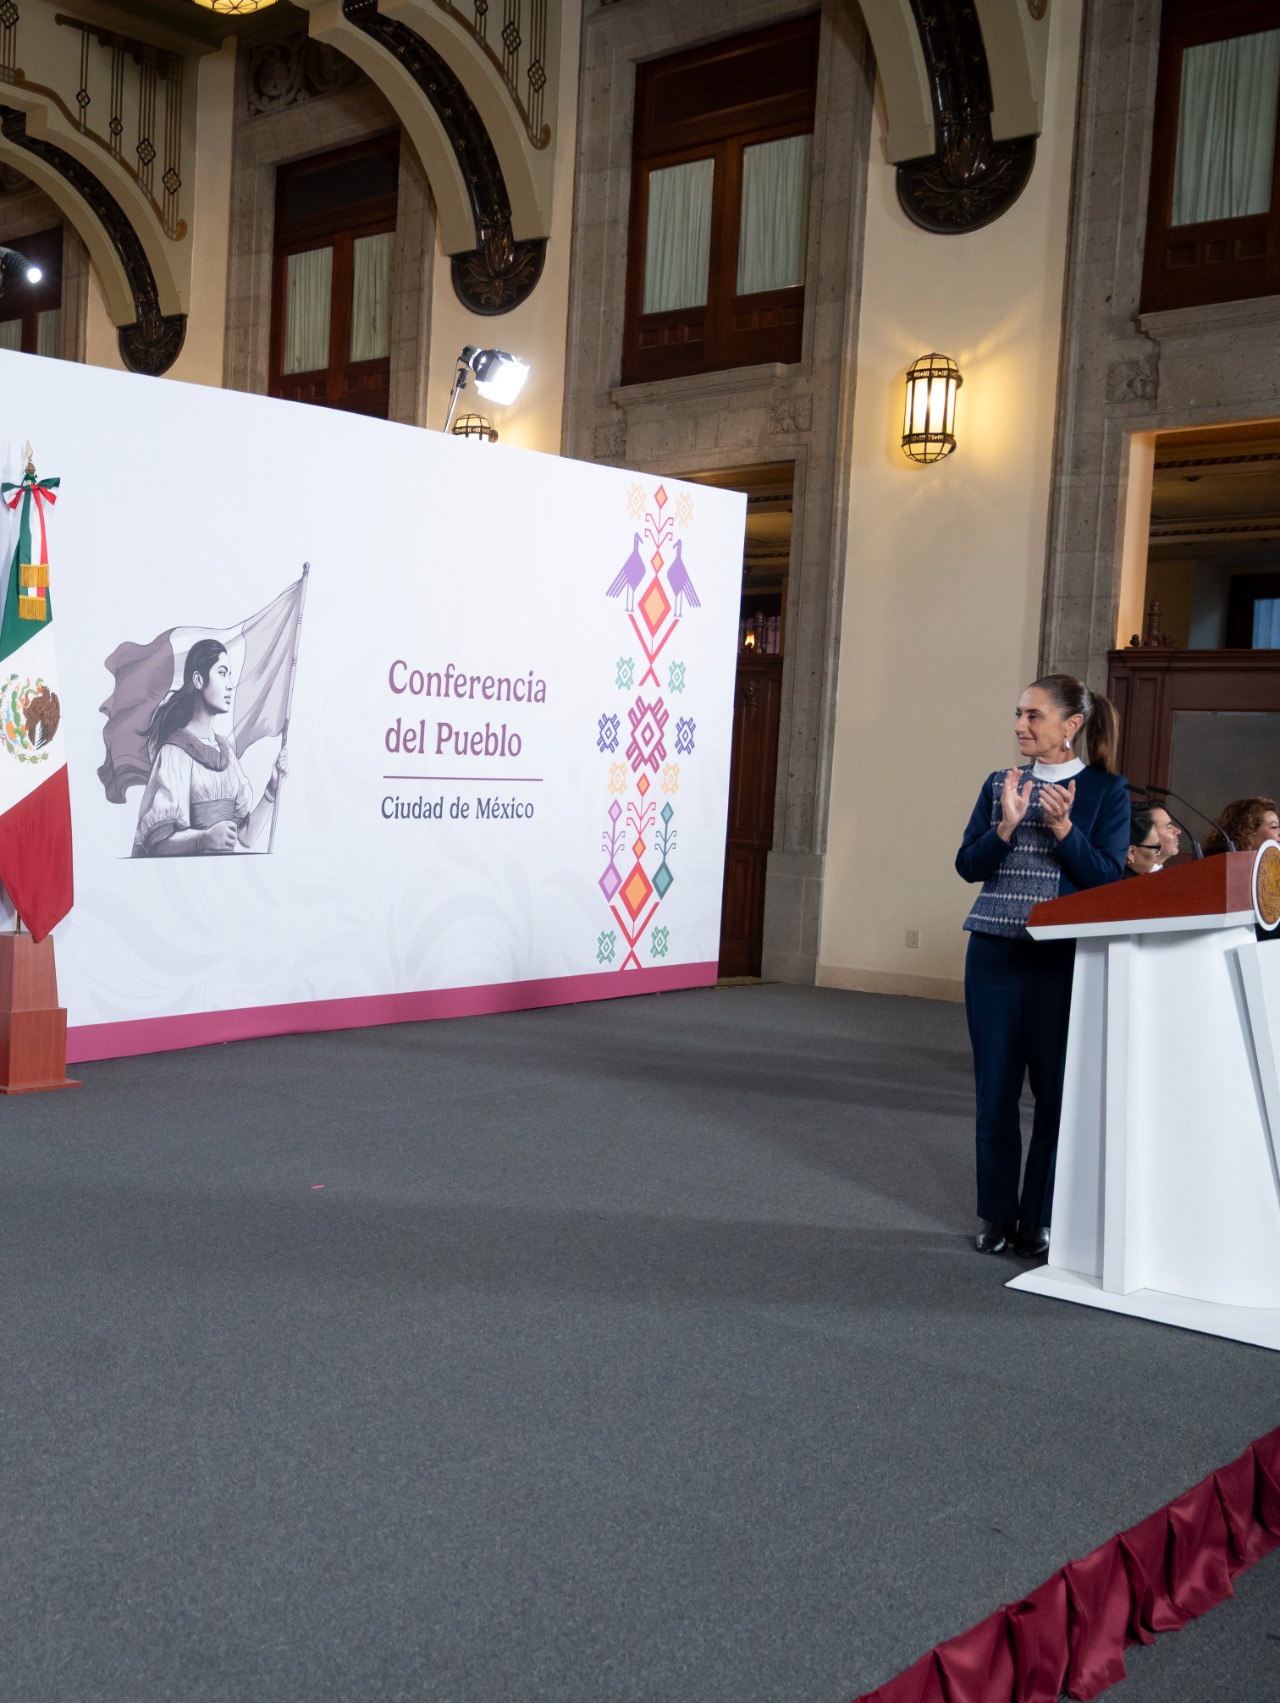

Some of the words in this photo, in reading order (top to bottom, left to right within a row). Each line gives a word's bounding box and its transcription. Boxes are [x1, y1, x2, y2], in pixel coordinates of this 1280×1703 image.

[388, 659, 547, 704] Conferencia
[384, 717, 426, 754] del
[435, 721, 522, 757] Pueblo
[381, 795, 444, 820] Ciudad
[450, 795, 470, 820] de
[475, 796, 535, 820] México
